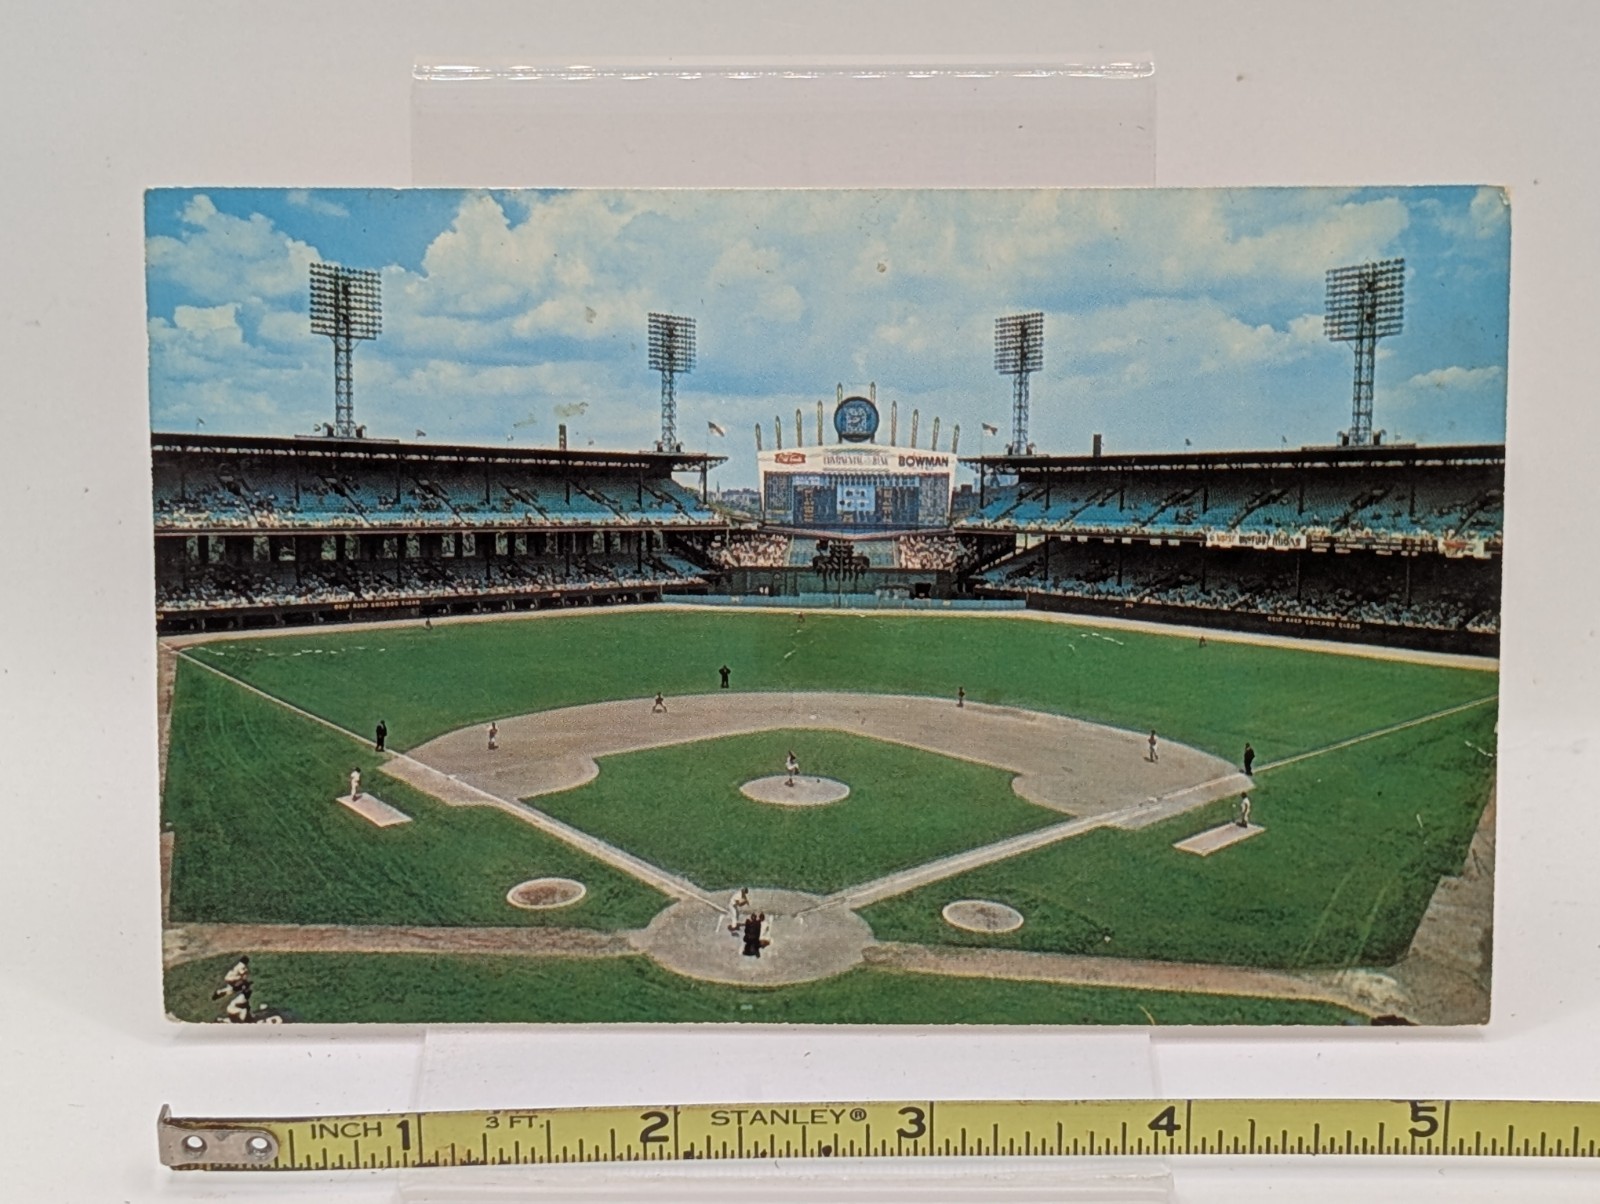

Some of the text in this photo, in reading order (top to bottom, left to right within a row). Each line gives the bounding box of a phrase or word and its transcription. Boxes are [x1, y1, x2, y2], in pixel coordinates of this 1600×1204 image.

[898, 455, 949, 467] BOWMAN
[311, 1120, 410, 1151] INCH 1
[486, 1115, 545, 1129] 3 FT.
[640, 1111, 669, 1143] 2
[897, 1106, 926, 1138] 3
[1148, 1106, 1181, 1137] 4
[1408, 1103, 1438, 1137] 5
